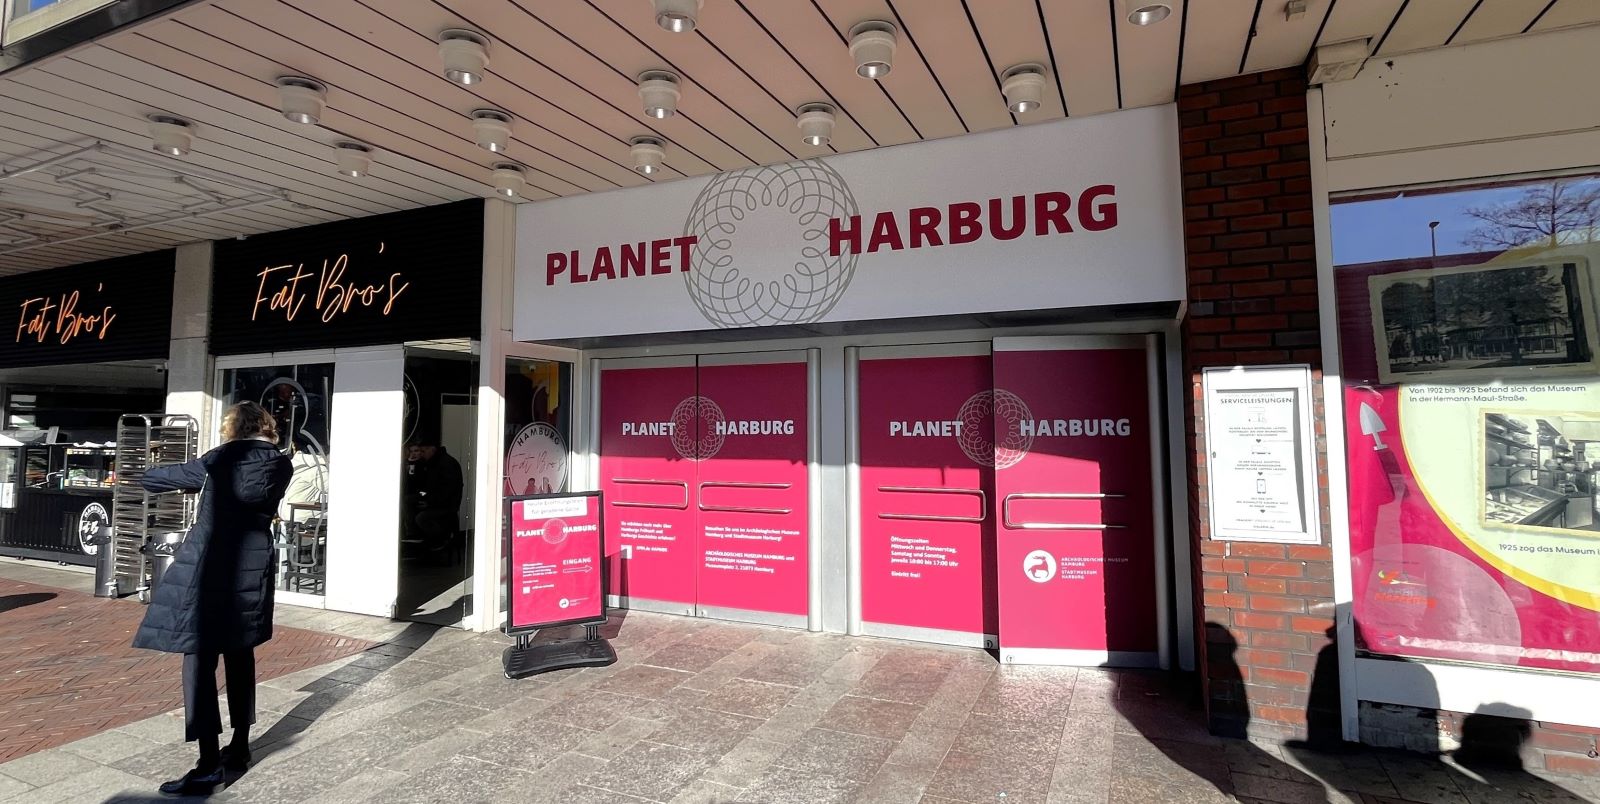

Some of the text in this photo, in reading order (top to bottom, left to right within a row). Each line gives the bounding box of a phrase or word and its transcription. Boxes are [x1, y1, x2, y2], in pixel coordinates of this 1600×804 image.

[546, 184, 1118, 286] PLANET HARBURG
[252, 242, 409, 323] Fat Bro's
[16, 283, 116, 344] Fat Bro's
[622, 419, 795, 436] PLANET HARBURG
[889, 418, 1131, 437] PLANET HARBURG
[516, 428, 561, 447] HAMBURG
[516, 524, 597, 537] PLANET HARBURG
[924, 552, 946, 560] Sonntag
[1499, 543, 1518, 551] 1925
[1536, 545, 1553, 553] das
[1555, 546, 1595, 555] Museum
[562, 557, 592, 565] EINGANG
